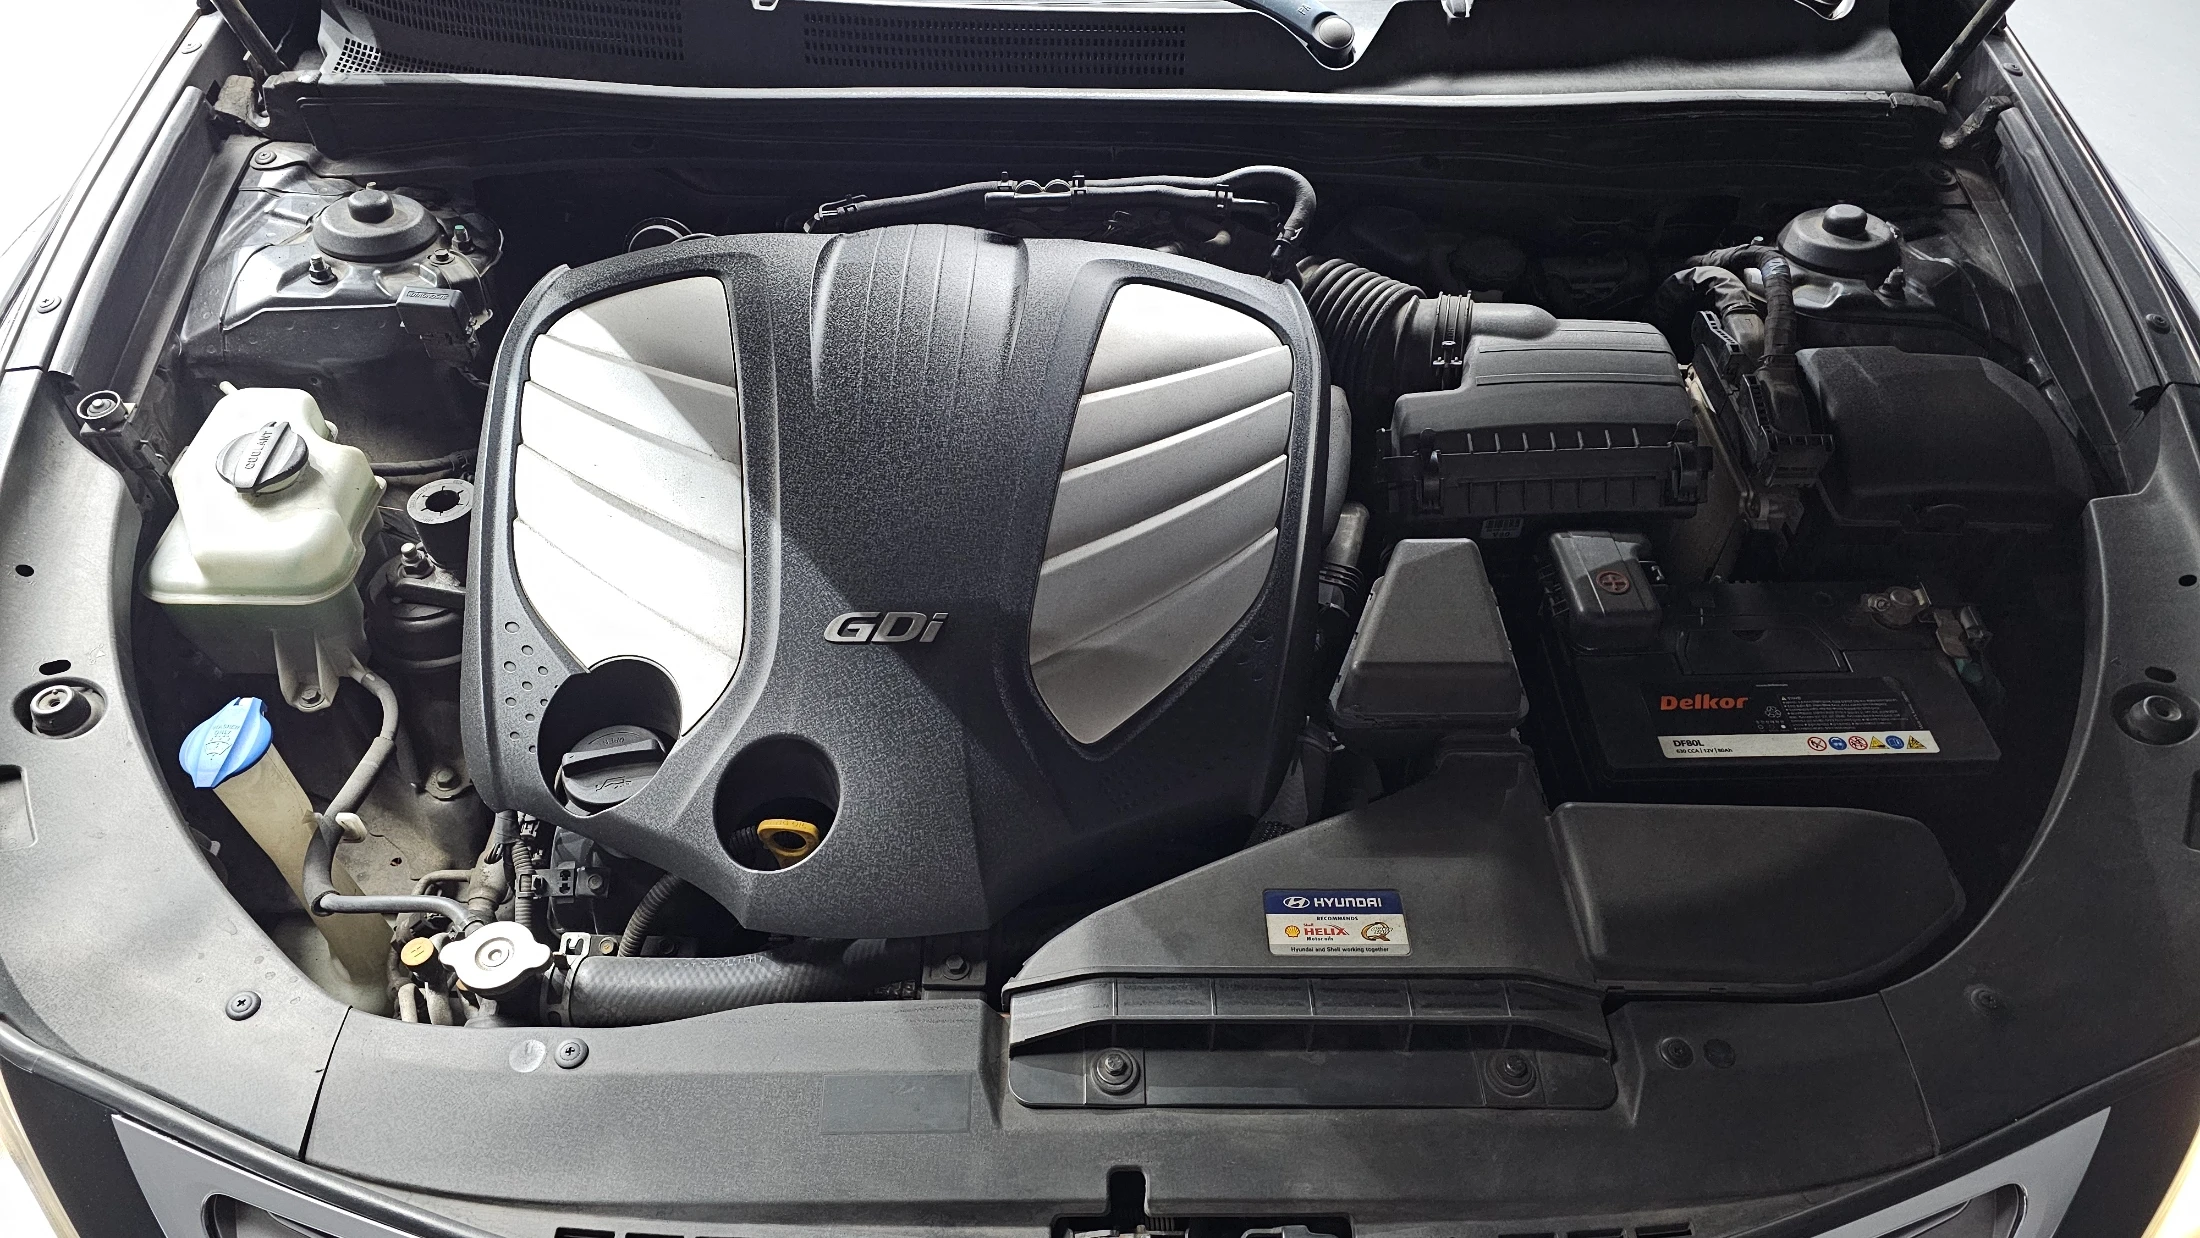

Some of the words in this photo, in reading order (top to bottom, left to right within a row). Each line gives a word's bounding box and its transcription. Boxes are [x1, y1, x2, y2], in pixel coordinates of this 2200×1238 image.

[244, 430, 272, 470] COOLANT
[823, 611, 949, 643] GDi
[1660, 693, 1748, 711] Delkor
[1672, 739, 1705, 747] DF80L
[1314, 897, 1382, 908] HYUNDAI
[1304, 928, 1348, 936] HELIX
